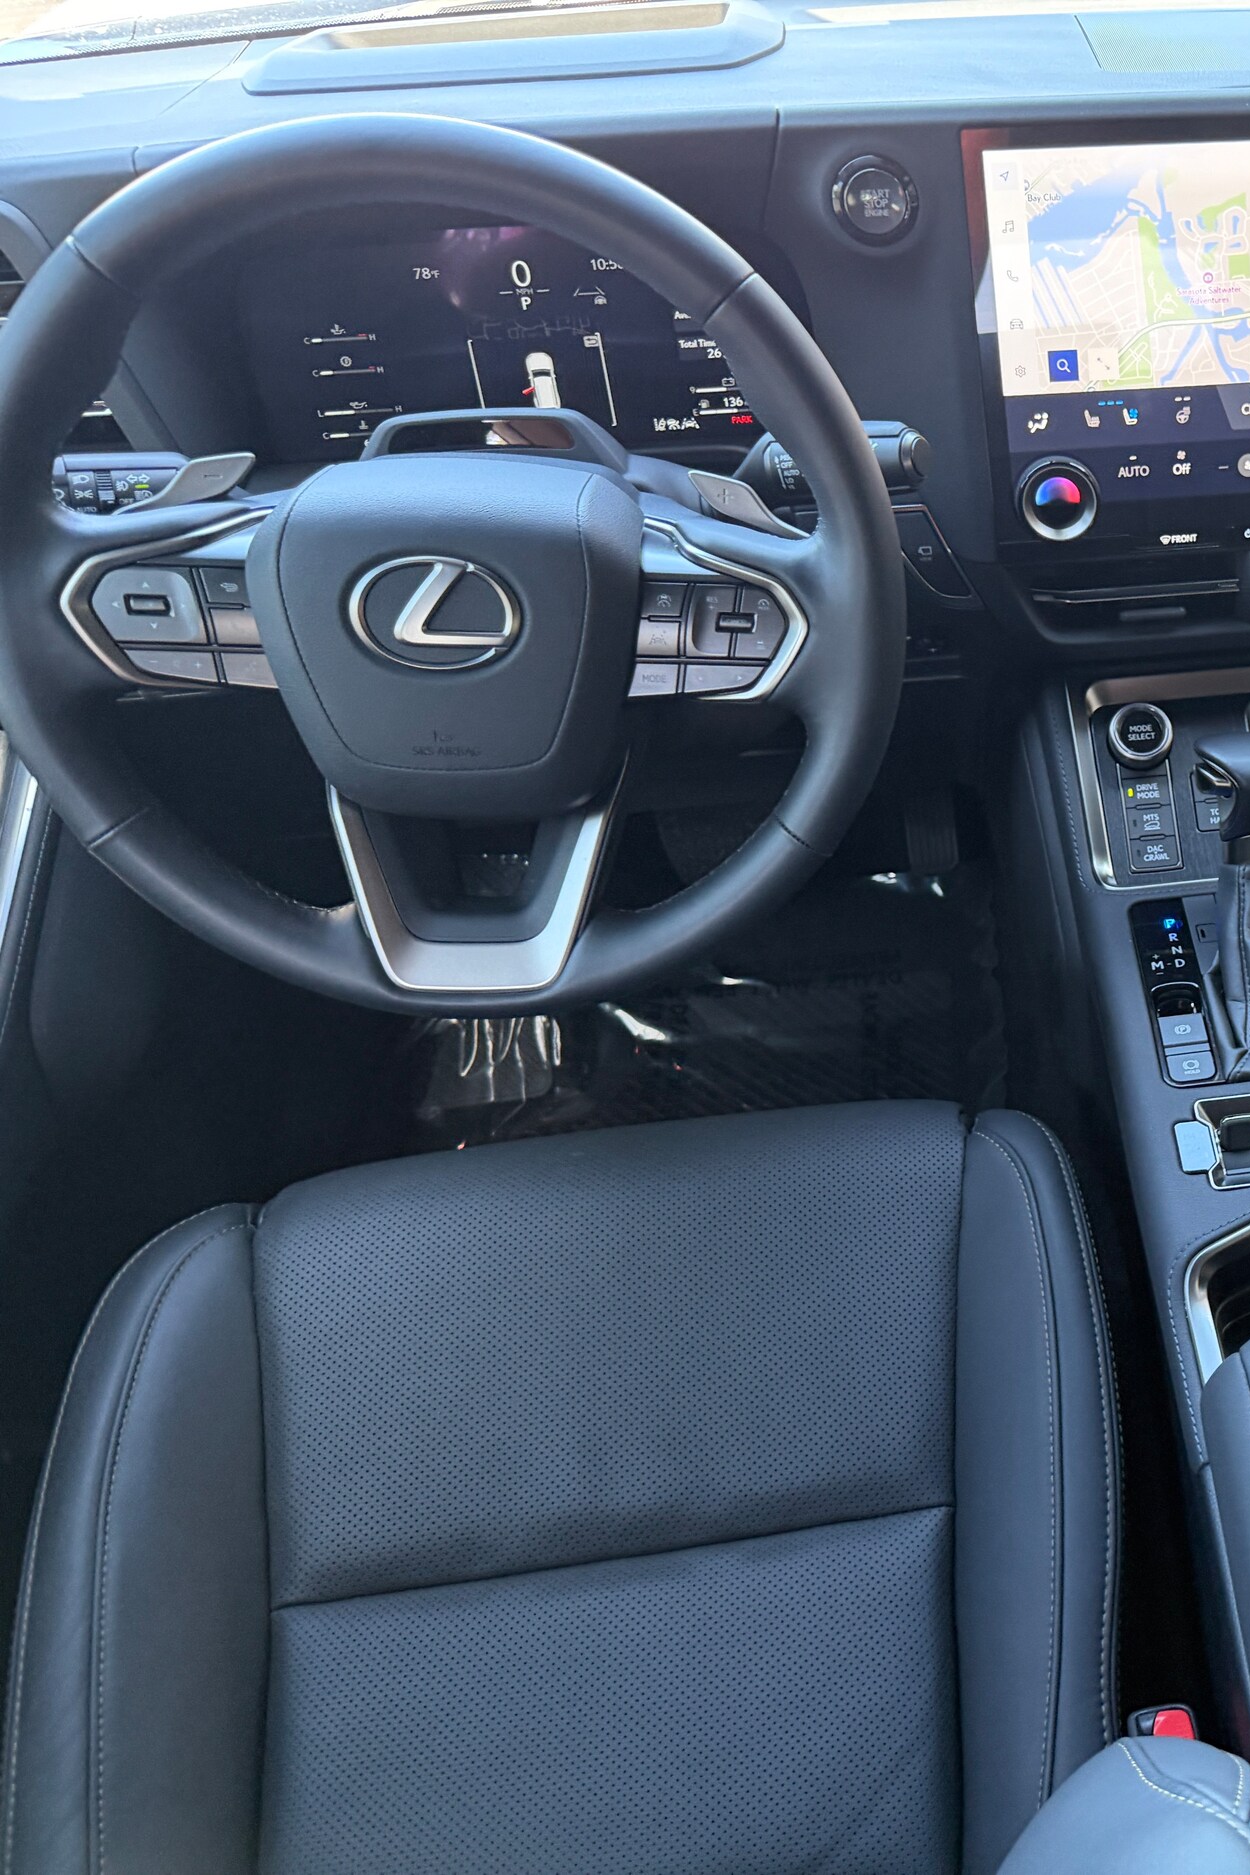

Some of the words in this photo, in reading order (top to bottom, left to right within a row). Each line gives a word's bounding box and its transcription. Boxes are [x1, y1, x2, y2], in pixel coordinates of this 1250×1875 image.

[860, 189, 890, 200] START
[1027, 194, 1041, 203] Bay
[1043, 193, 1061, 202] Club
[864, 199, 888, 208] STOP
[864, 209, 889, 217] ENGINE
[511, 260, 531, 287] 0
[516, 288, 534, 296] MPH
[1177, 287, 1207, 296] Sarasota
[1208, 285, 1241, 294] Saltwater
[521, 297, 532, 311] P
[1189, 296, 1229, 305] Adventures
[678, 339, 698, 349] Total
[707, 348, 722, 359] 26
[723, 397, 744, 408] 136
[731, 415, 753, 424] PARK
[1118, 465, 1150, 479] AUTO
[1172, 463, 1191, 475] Off
[1171, 533, 1198, 544] FRONT
[642, 673, 667, 683] MODE
[1129, 724, 1153, 733] MODE
[1128, 732, 1156, 742] SELECT
[1136, 782, 1159, 792] DRIVE
[1137, 790, 1160, 800] MODE
[1143, 813, 1160, 822] MTS
[1147, 844, 1164, 853] DAC
[1144, 853, 1170, 862] CRAWL
[1164, 918, 1176, 929] P
[1168, 933, 1179, 942] R
[1171, 946, 1183, 955] N
[1151, 960, 1165, 971] M
[1174, 958, 1186, 968] D
